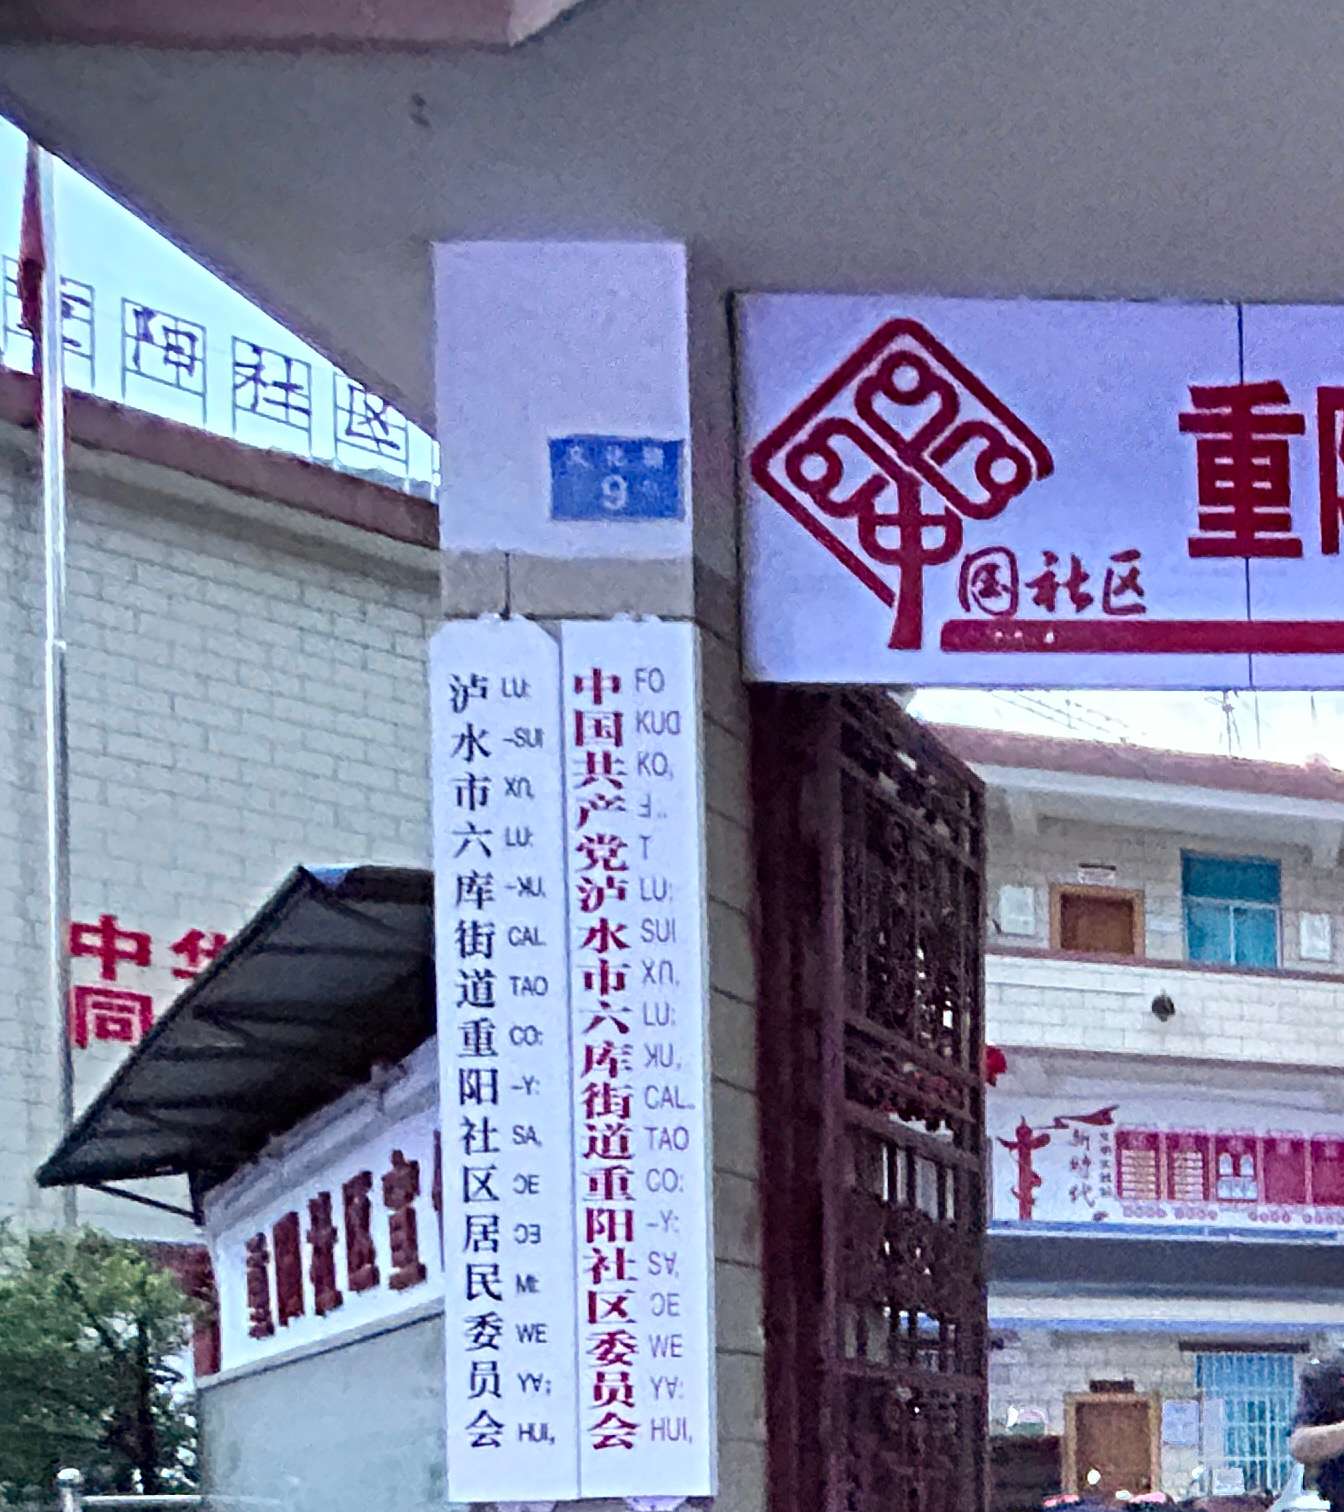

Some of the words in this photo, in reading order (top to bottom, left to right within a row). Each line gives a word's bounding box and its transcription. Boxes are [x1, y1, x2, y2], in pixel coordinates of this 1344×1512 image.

[10, 280, 402, 452] 阳社区
[449, 673, 505, 1449] 泸水市六库街道重阳社区居民委员会
[573, 668, 640, 1450] 中国共产党泸水市六库街道重阳社区委员会
